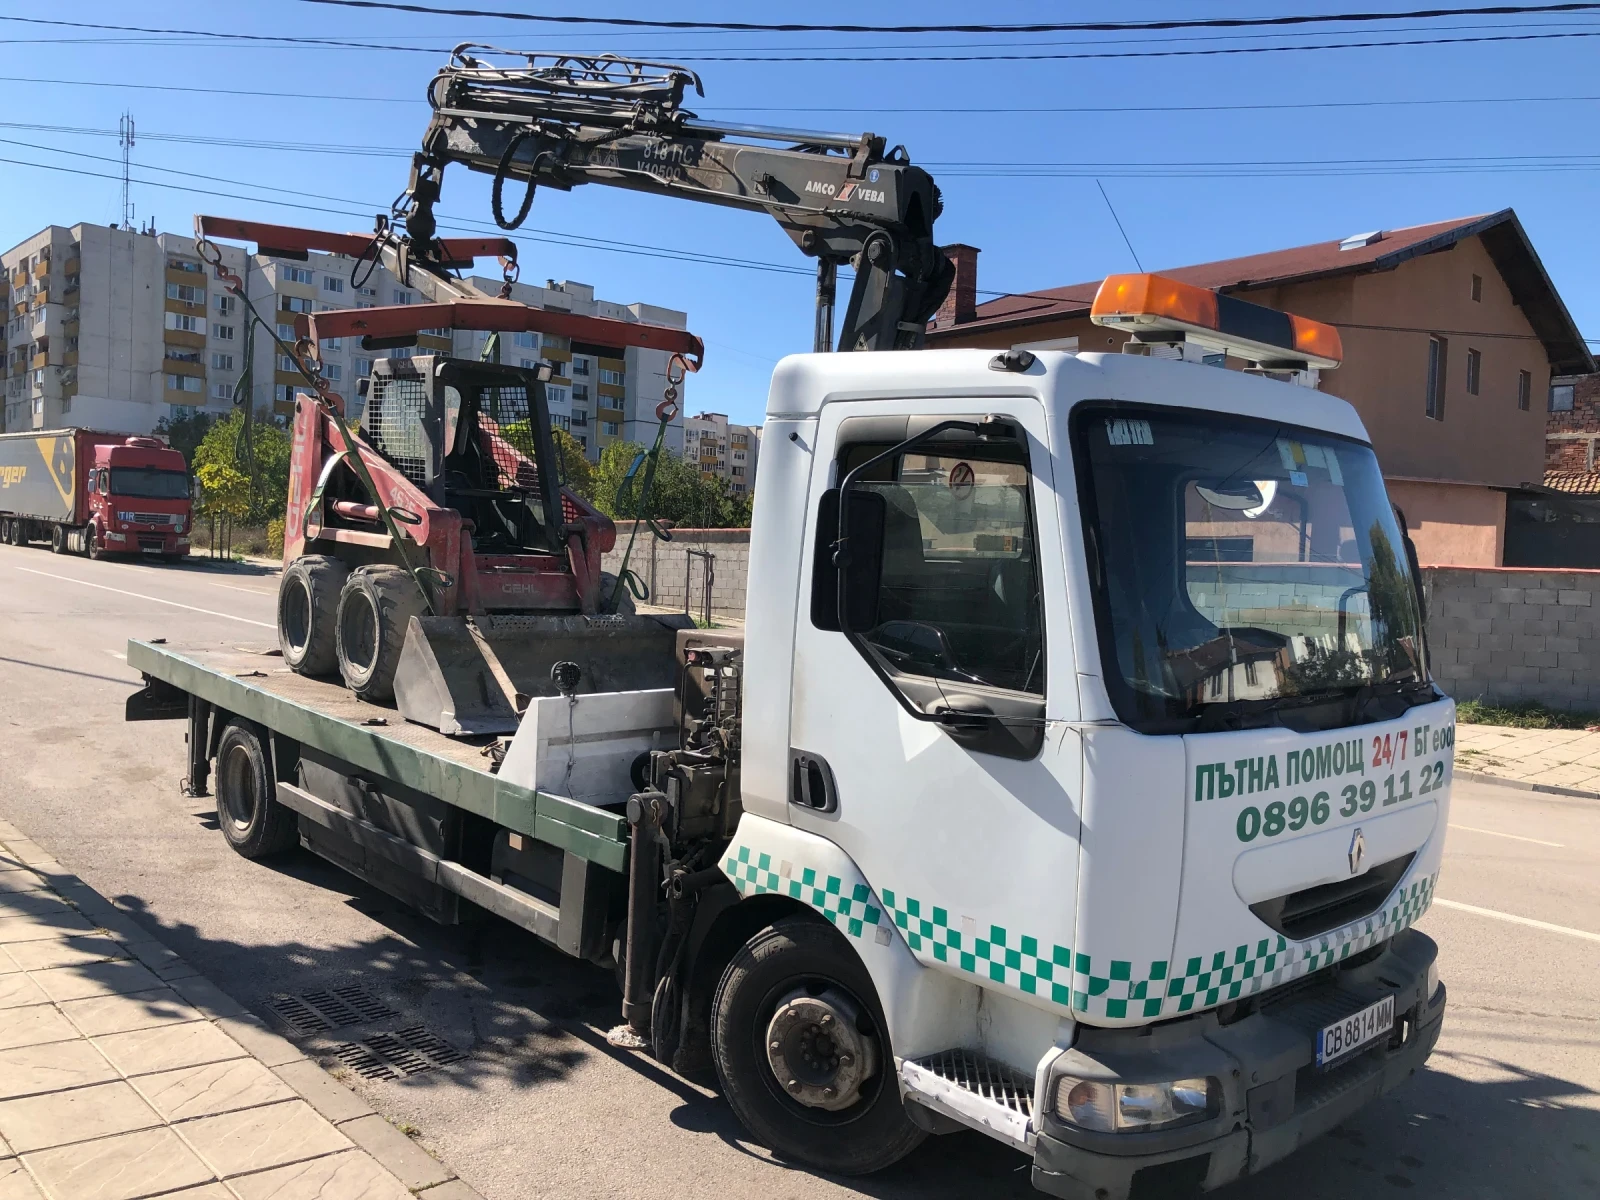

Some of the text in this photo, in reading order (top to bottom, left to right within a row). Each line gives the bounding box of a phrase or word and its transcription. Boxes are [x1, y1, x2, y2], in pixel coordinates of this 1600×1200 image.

[805, 180, 885, 204] AMCO VEBA
[119, 511, 135, 521] TIR
[501, 583, 540, 594] GEHL
[1195, 754, 1280, 802] ПЪТНА
[1286, 738, 1365, 787] ПОМОЩ
[1371, 730, 1408, 770] 24/7
[1414, 725, 1430, 758] БГ
[1236, 761, 1445, 843] 0896 39 11 22
[1344, 1008, 1375, 1048] 8814
